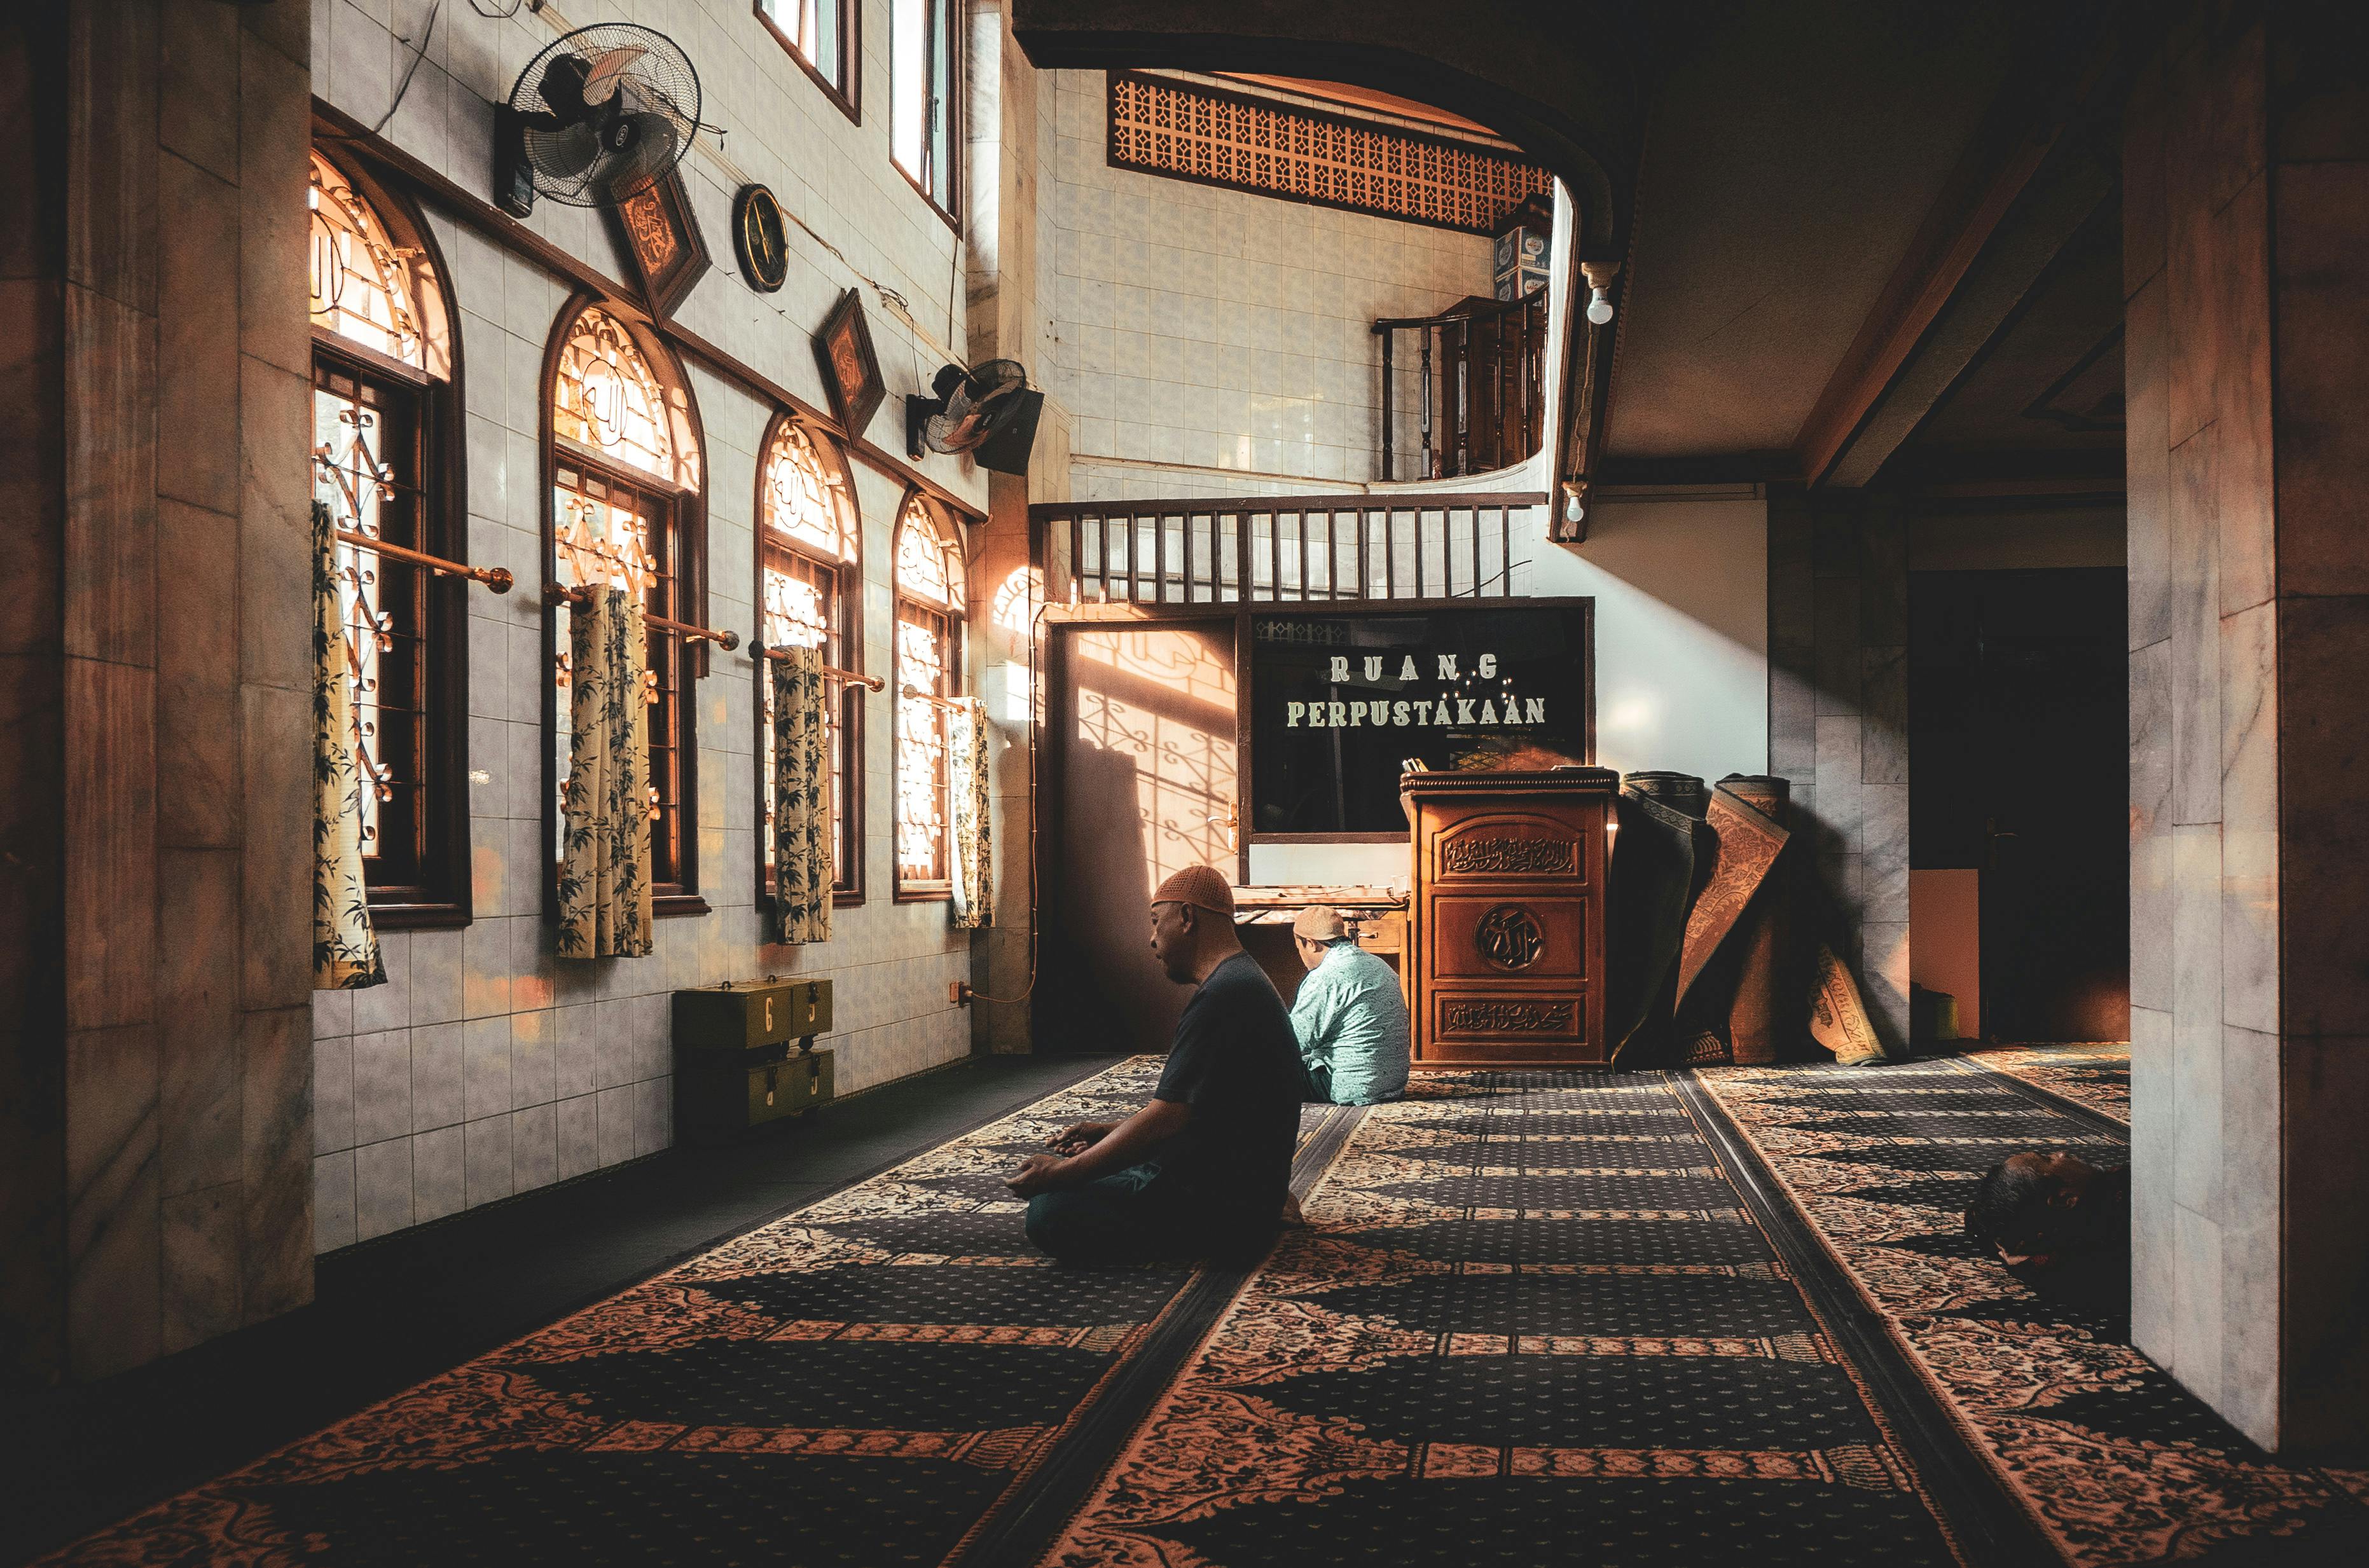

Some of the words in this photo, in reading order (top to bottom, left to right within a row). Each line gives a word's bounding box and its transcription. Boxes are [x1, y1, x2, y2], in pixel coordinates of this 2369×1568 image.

[1330, 654, 1497, 682] RUANG
[1287, 698, 1546, 727] PERPUSTAKAAN
[765, 996, 773, 1033] 6
